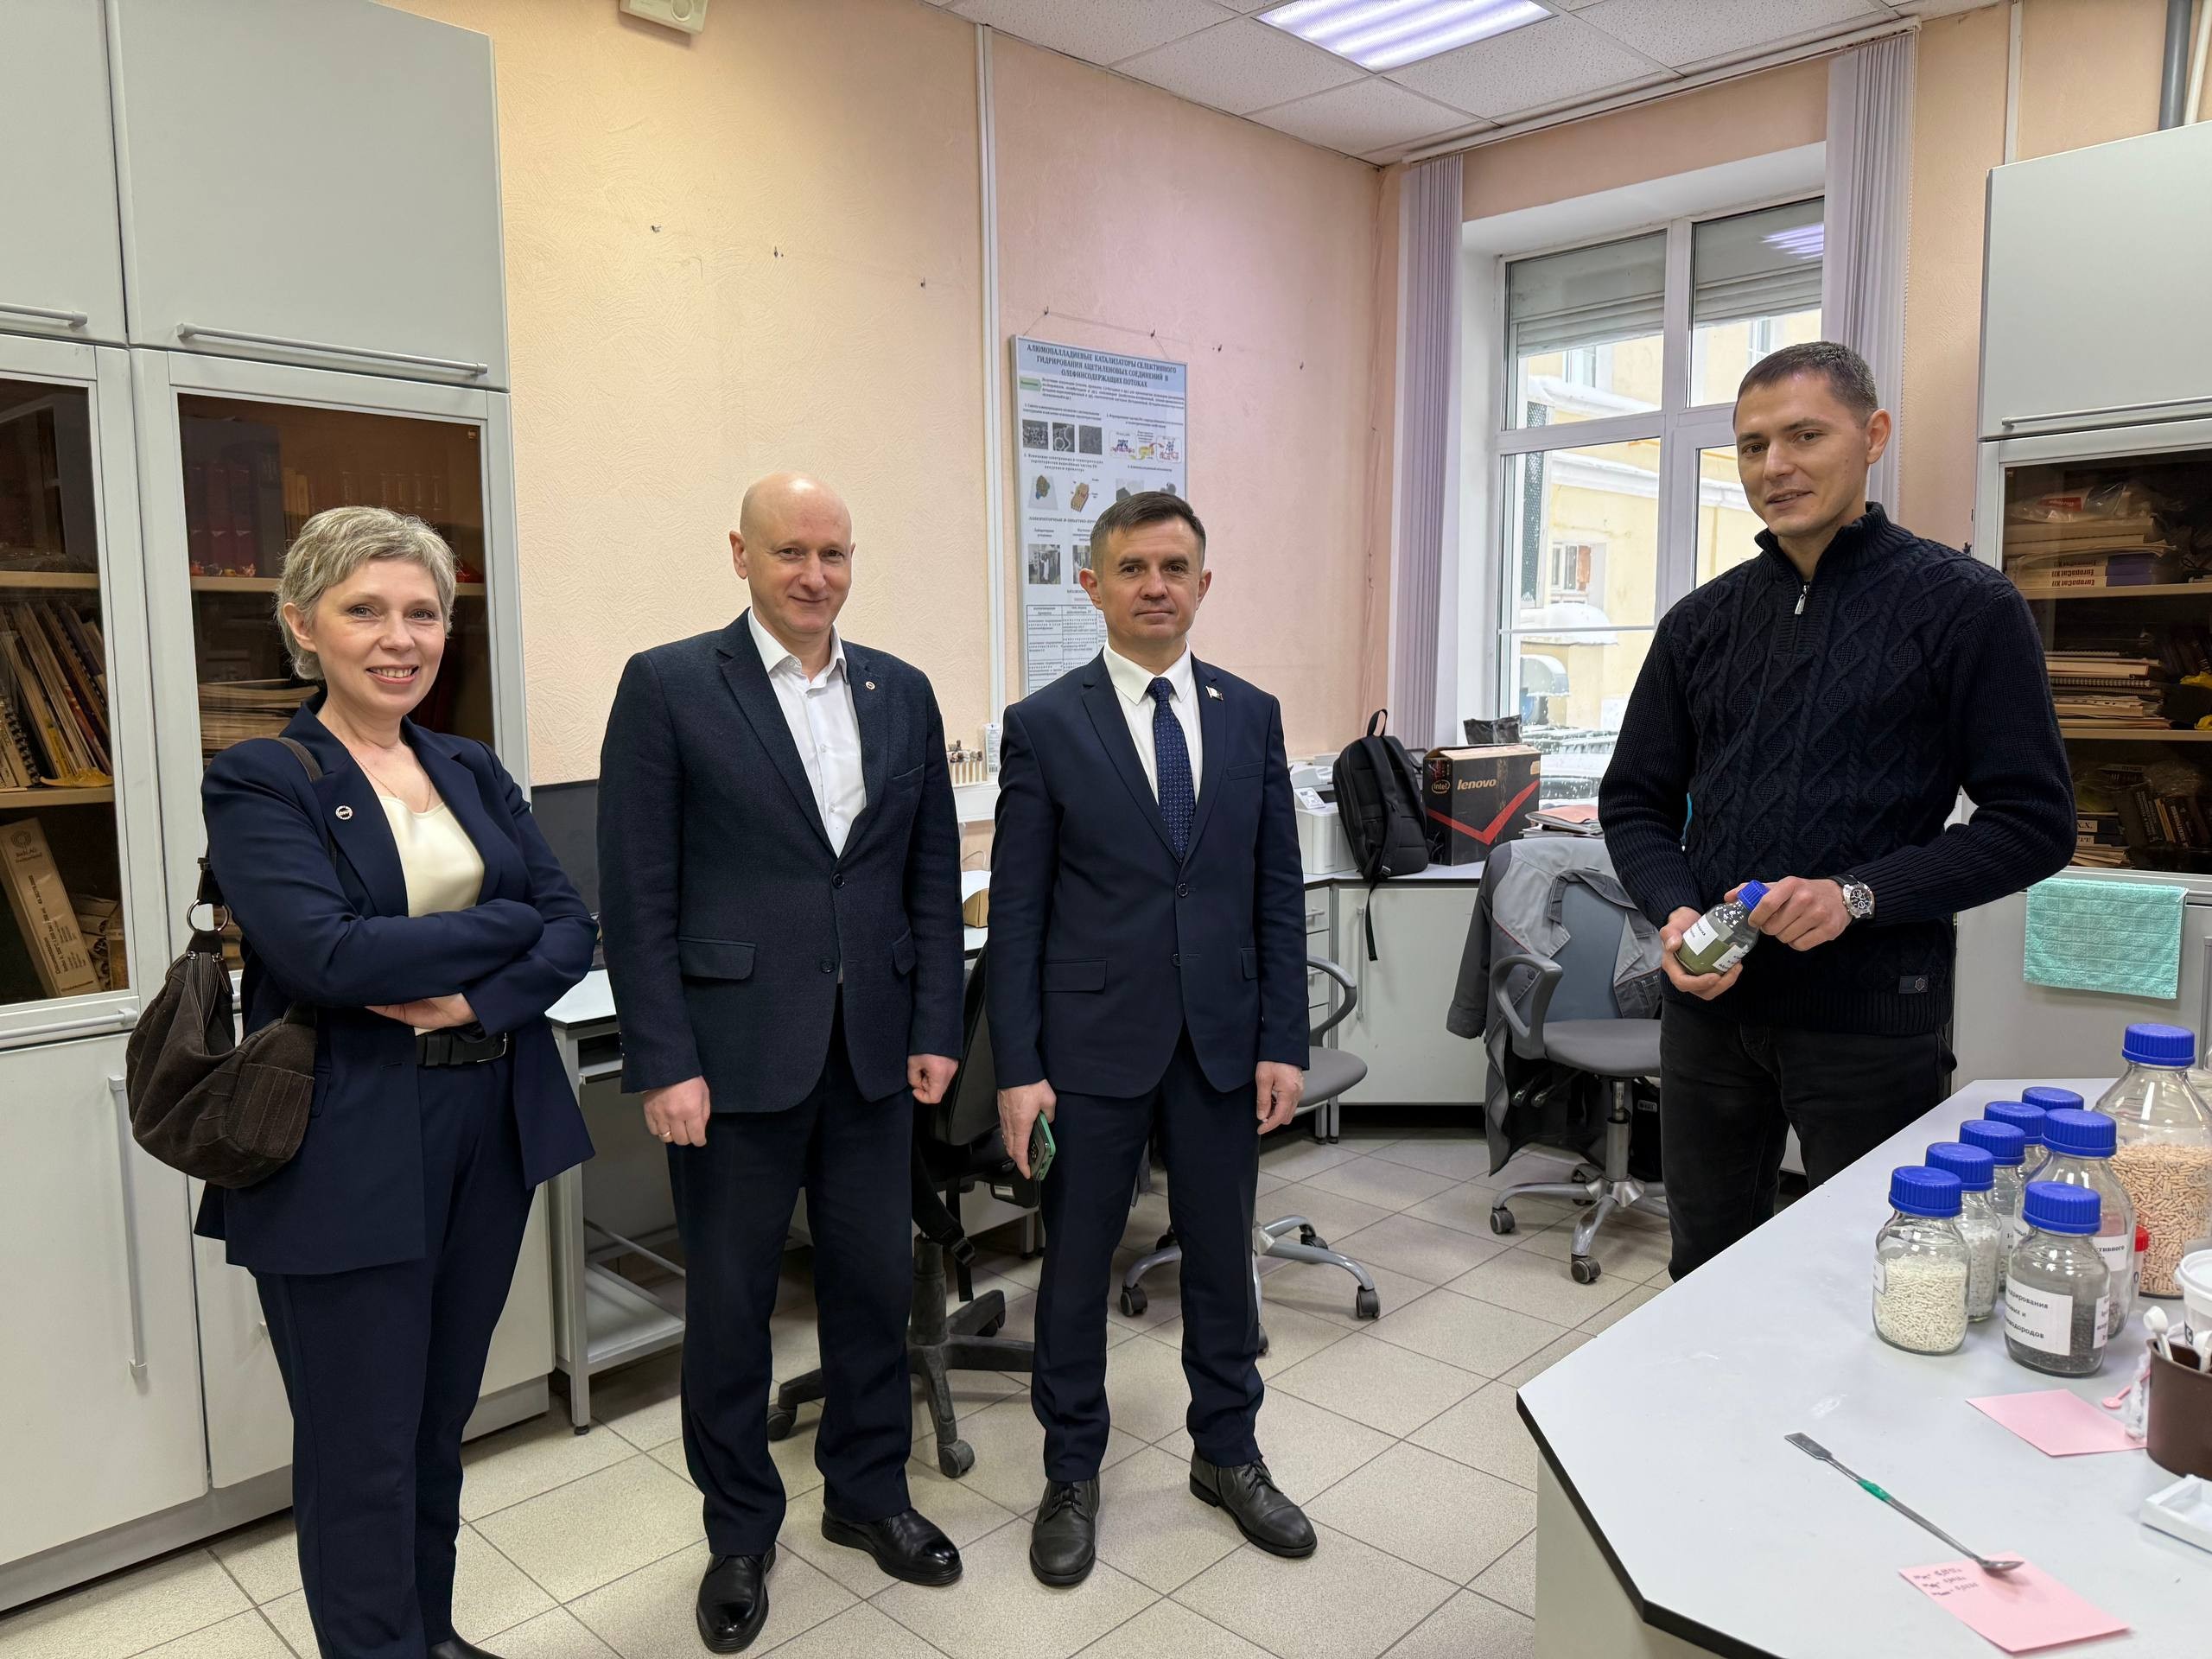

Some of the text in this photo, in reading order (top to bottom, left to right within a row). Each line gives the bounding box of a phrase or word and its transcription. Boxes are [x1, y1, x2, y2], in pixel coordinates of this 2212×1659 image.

[1027, 344, 1177, 373] АЛЮМОПАЛЛАДИЕВЫЕ КАТАЛИЗАТОРЫ СЕЛЕКТИВНОГО
[1036, 356, 1083, 370] ГИДРИРОВАНИЯ
[1084, 363, 1128, 375] АЦЕТИЛЕНОВЫХ
[1128, 369, 1163, 380] СОЕДИНЕНИЙ
[1061, 369, 1147, 387] ОЛЕФИНСОДЕРЖАЩИХ ПОТОКАХ
[1458, 779, 1497, 791] lenovo
